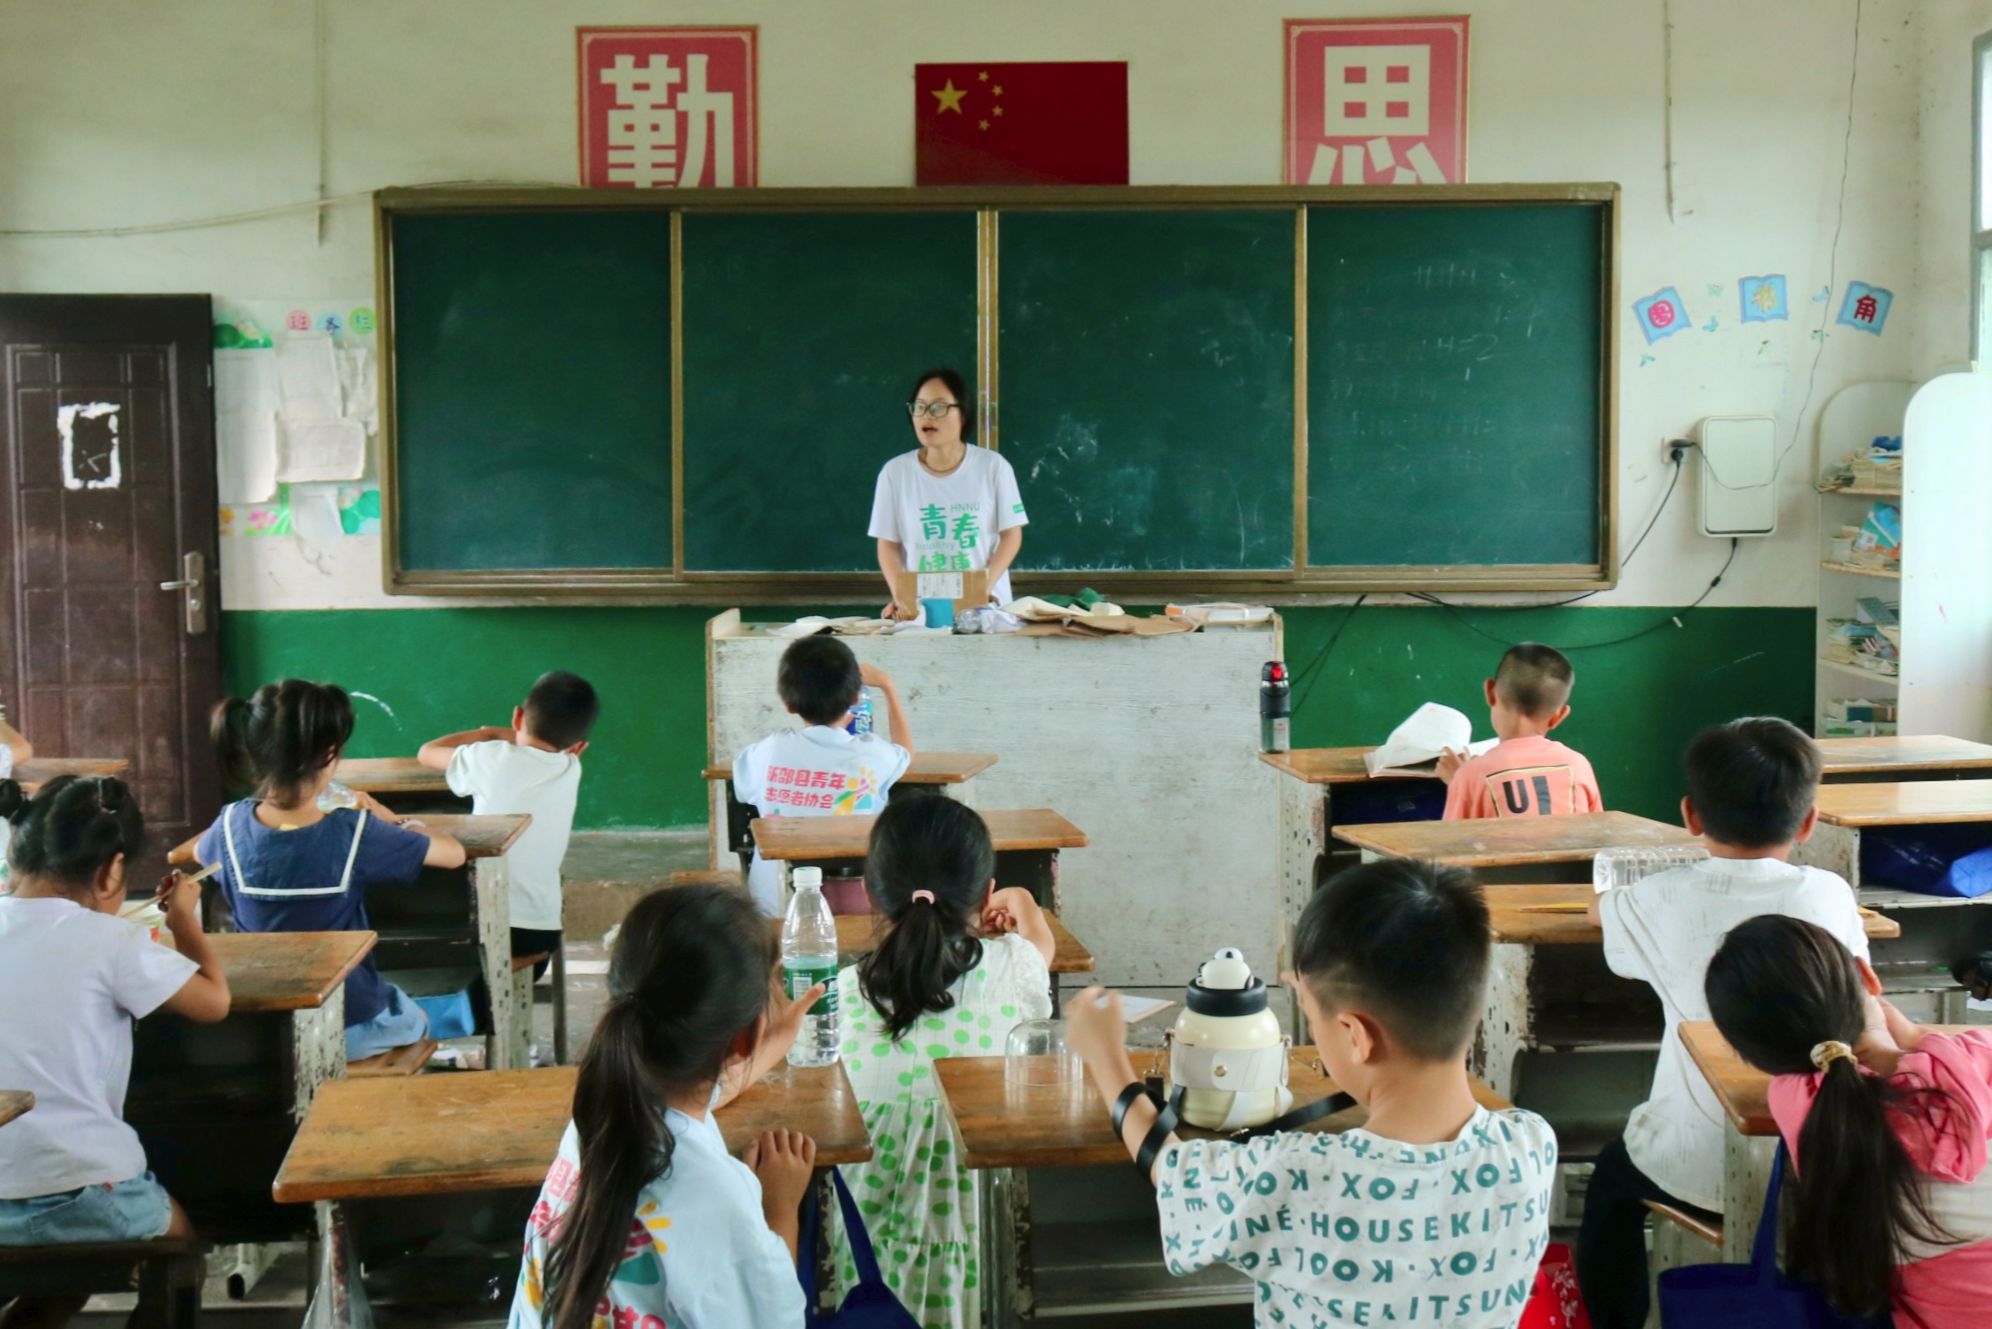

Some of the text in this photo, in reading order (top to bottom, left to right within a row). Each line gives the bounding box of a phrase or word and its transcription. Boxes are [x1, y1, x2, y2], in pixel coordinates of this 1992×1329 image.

[600, 54, 736, 188] 勤
[1307, 45, 1447, 185] 思
[919, 503, 981, 549] 青春
